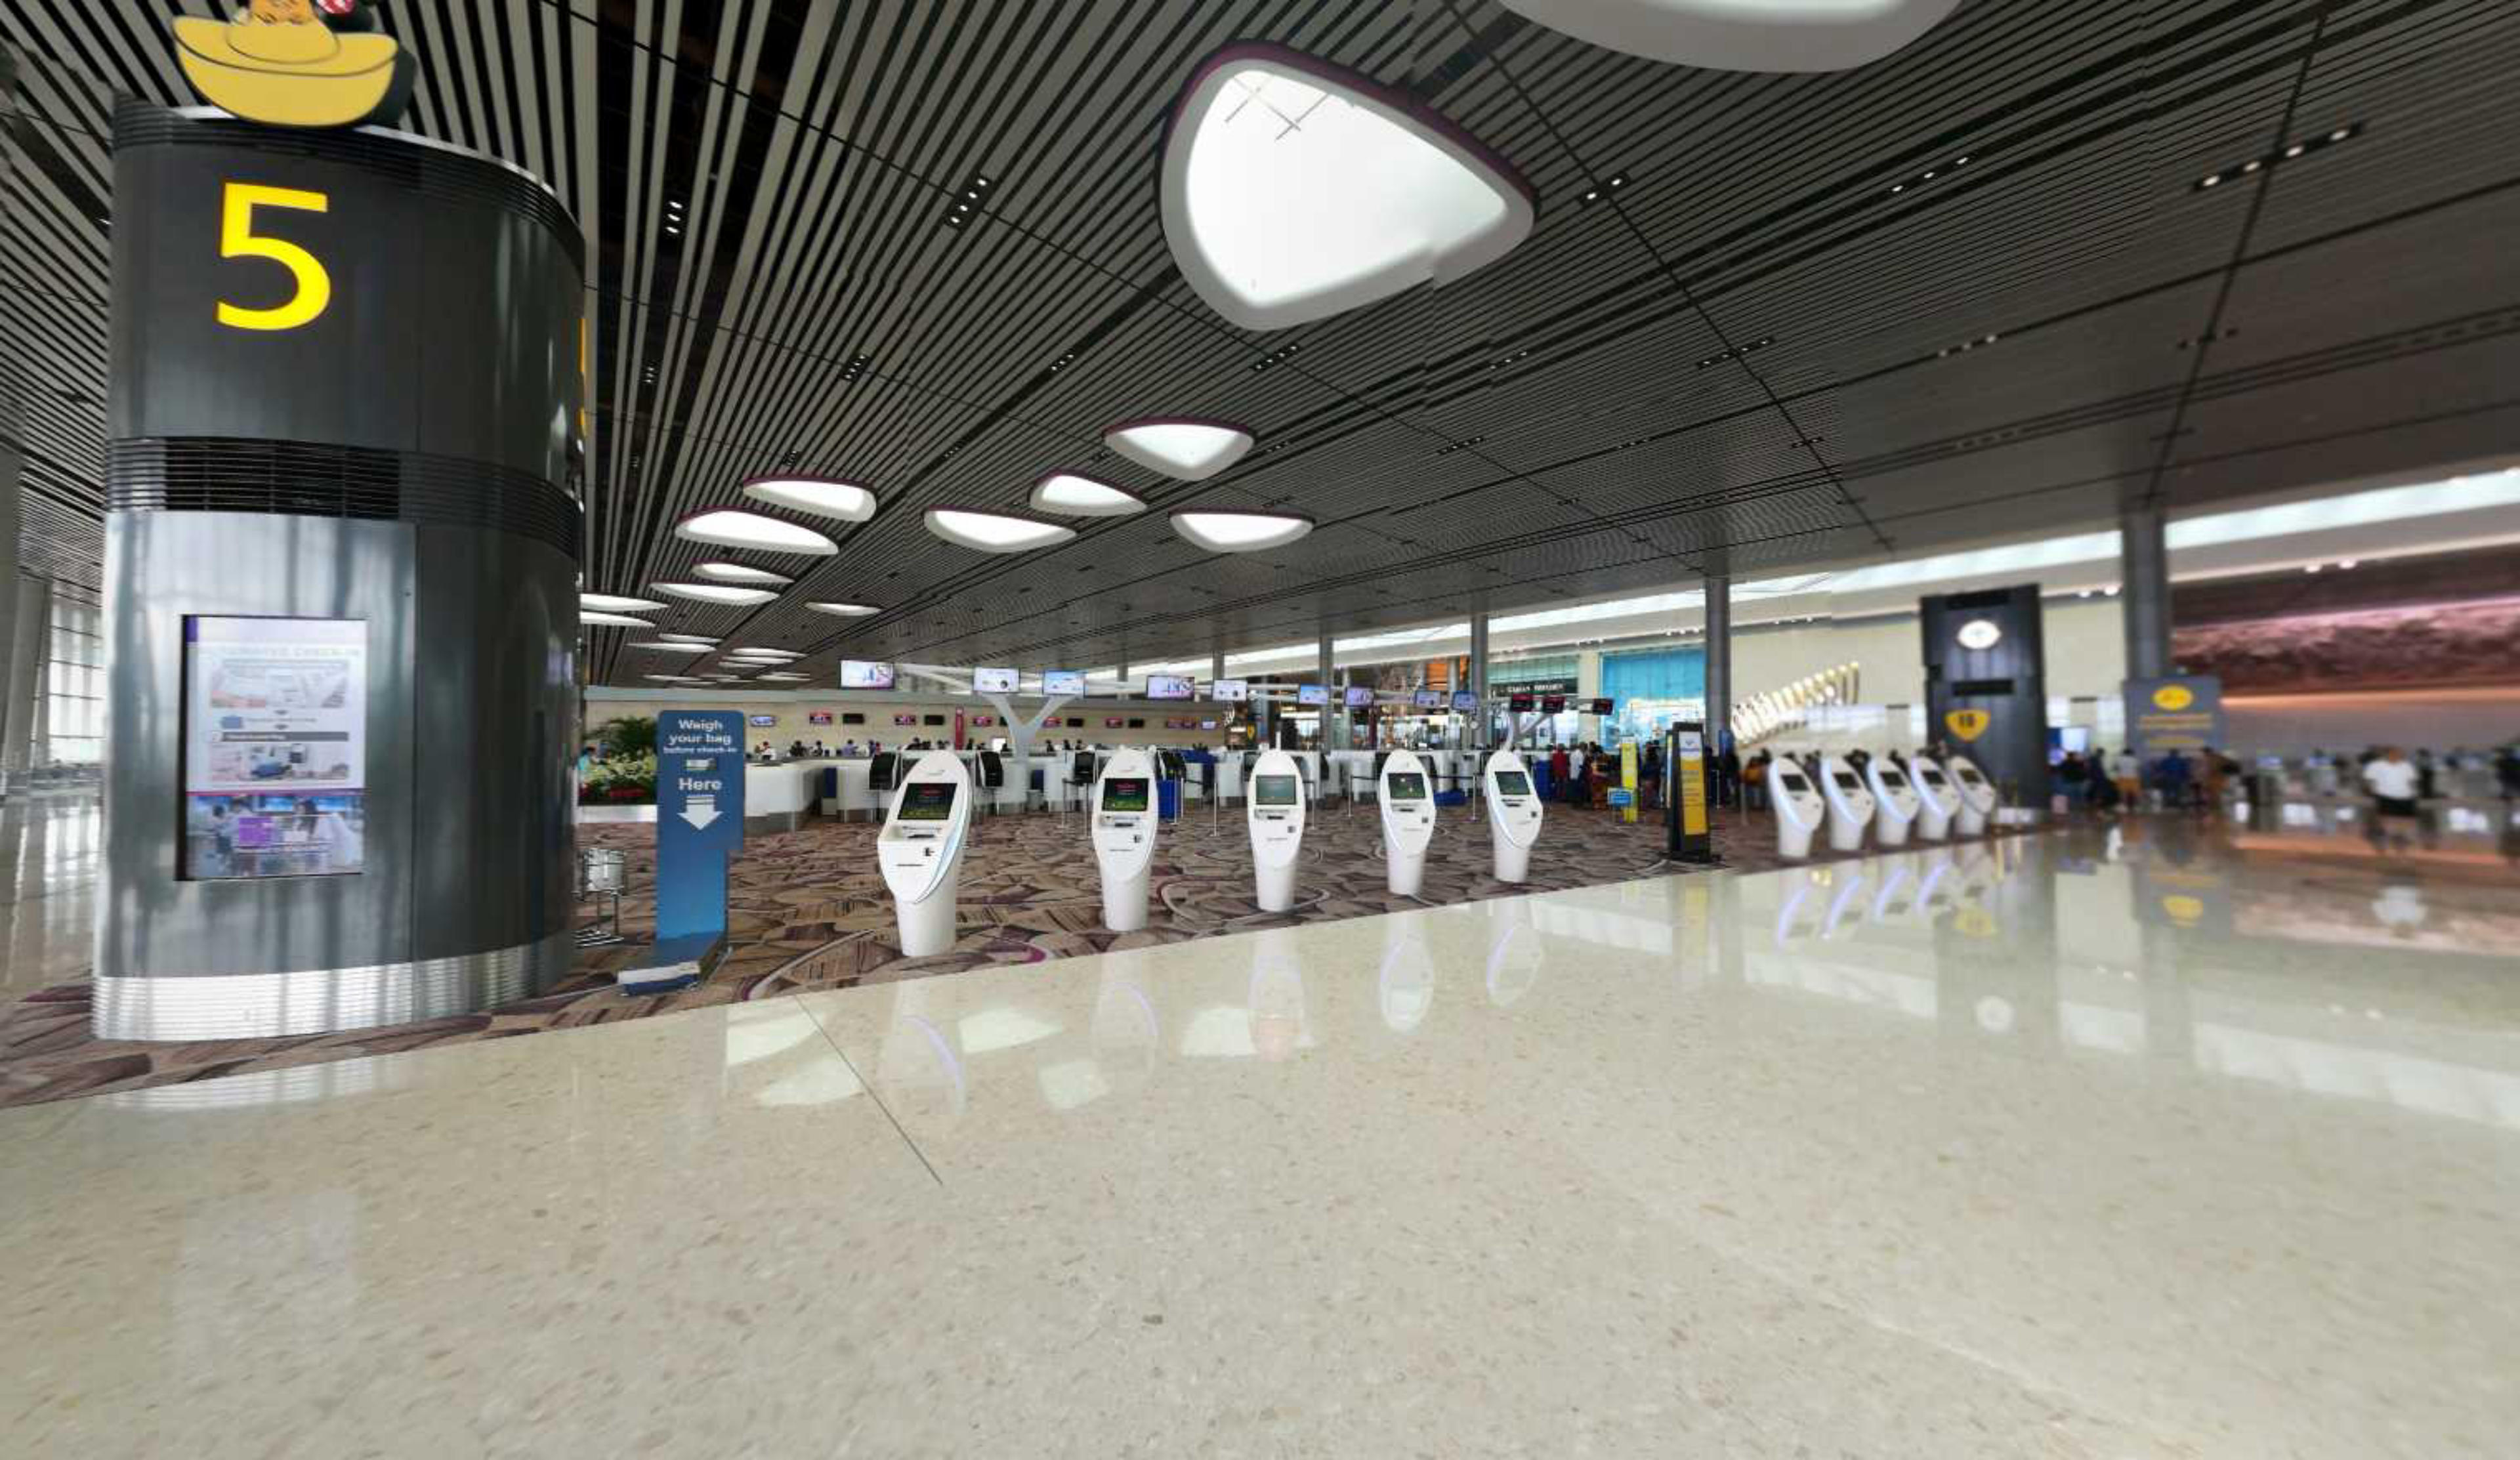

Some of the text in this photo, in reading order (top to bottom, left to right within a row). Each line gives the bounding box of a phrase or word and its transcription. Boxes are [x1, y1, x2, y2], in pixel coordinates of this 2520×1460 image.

[215, 182, 332, 331] 5
[678, 719, 723, 732] Weigh
[668, 733, 732, 745] your bag
[678, 778, 723, 791] Here
